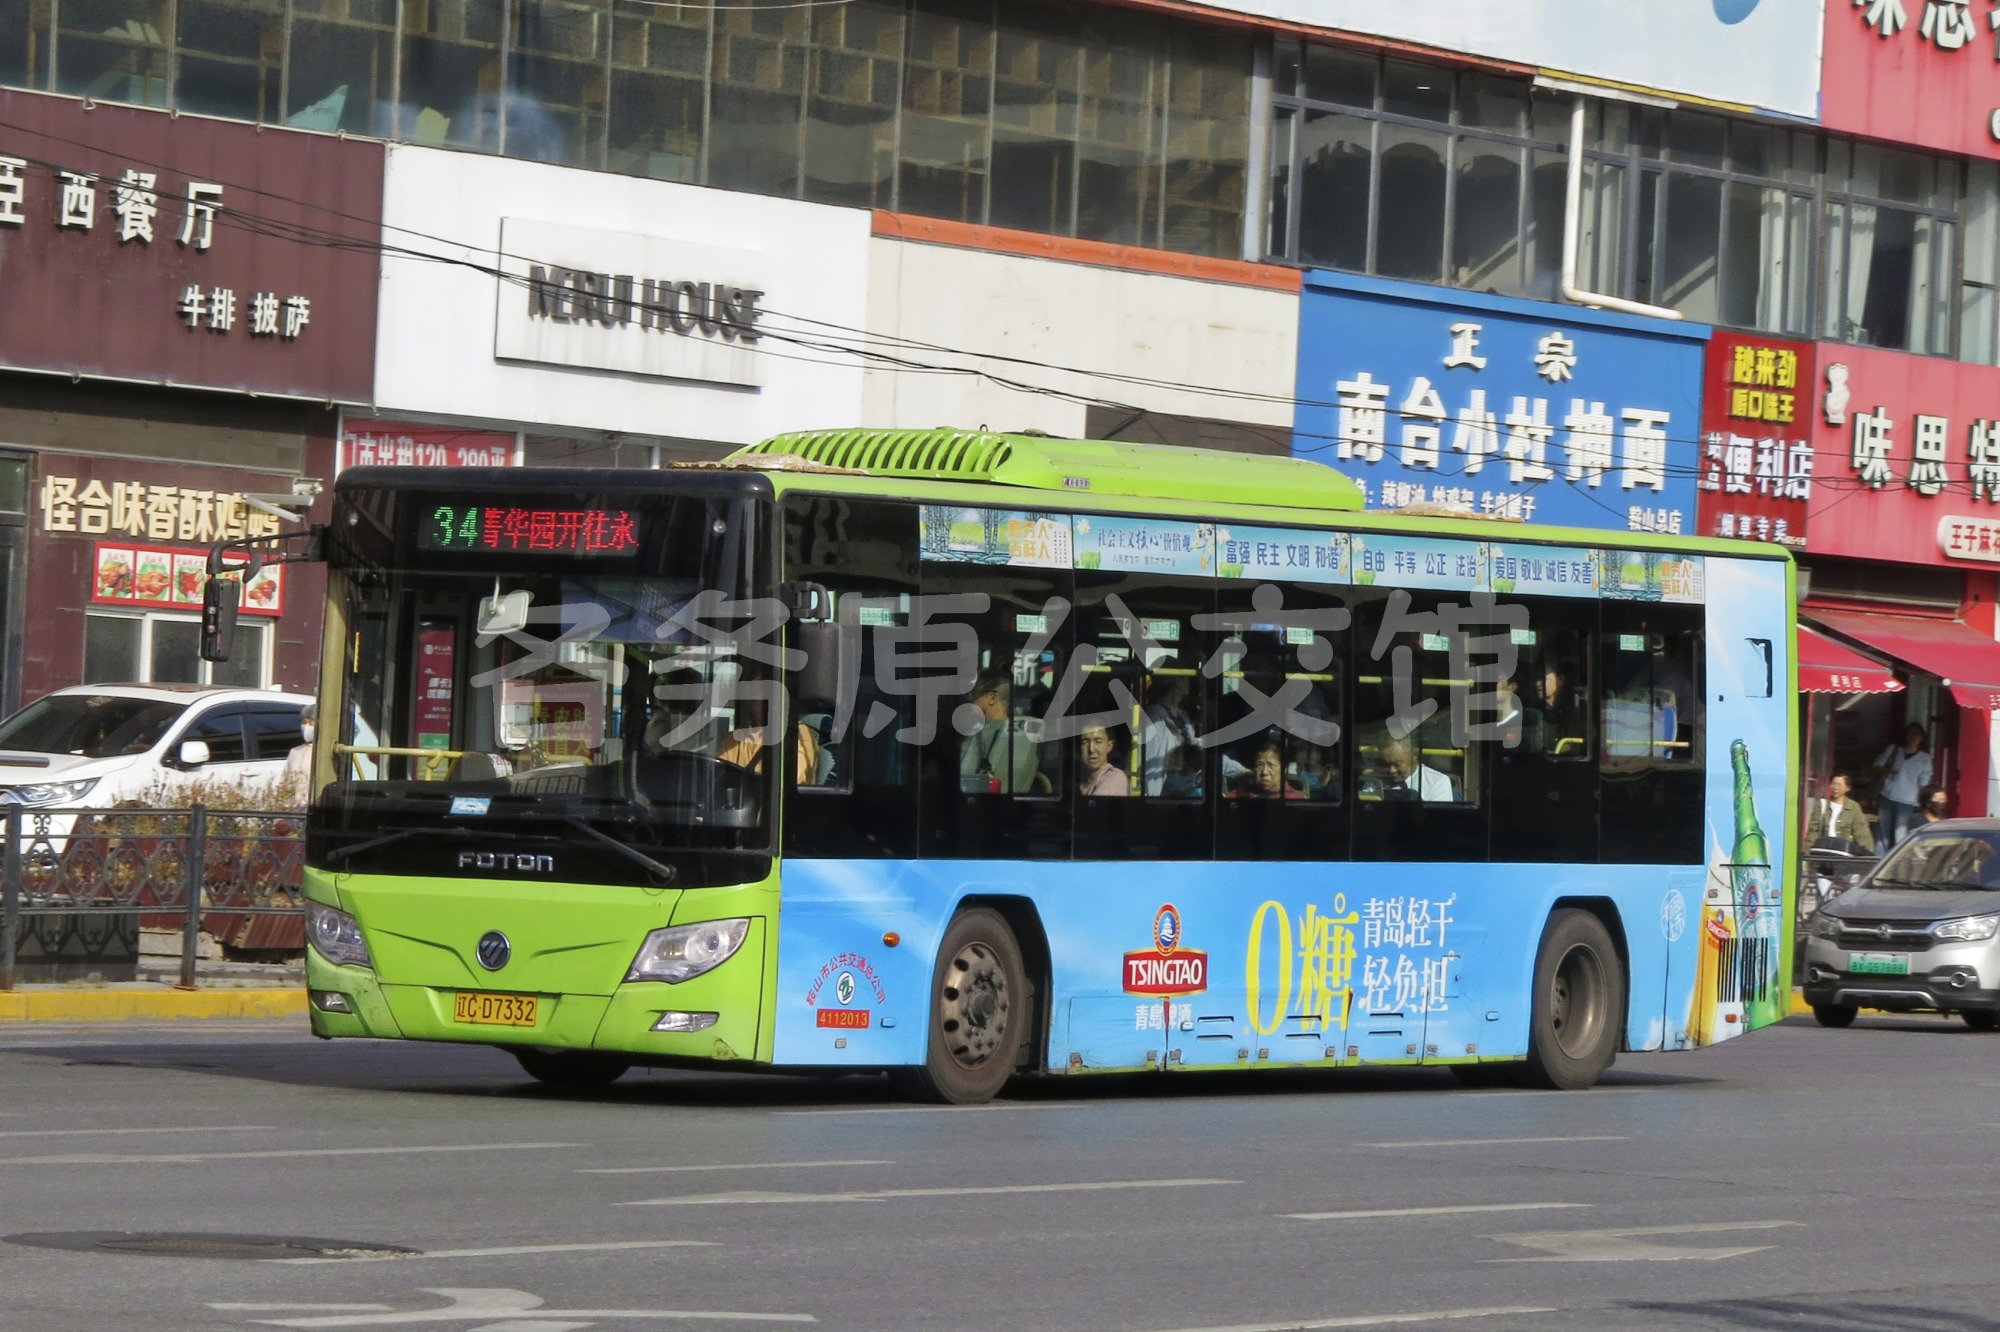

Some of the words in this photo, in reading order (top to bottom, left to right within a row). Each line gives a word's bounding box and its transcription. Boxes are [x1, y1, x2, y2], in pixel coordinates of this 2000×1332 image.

[181, 285, 236, 332] 牛排
[251, 292, 310, 337] 披萨
[528, 265, 634, 330] MERU
[640, 279, 765, 345] HOUSE
[1442, 322, 1577, 382] 正宗
[1725, 433, 1815, 501] 便利店
[433, 505, 479, 547] 34
[1225, 540, 1251, 565] 富强
[1256, 542, 1281, 567] 民主
[1286, 543, 1310, 568] 文明
[1315, 545, 1339, 571] 和谐
[1363, 549, 1386, 573] 自由
[1394, 550, 1417, 575] 平等
[1425, 552, 1448, 577] 公正
[1455, 554, 1477, 578] 法治
[1494, 557, 1517, 580] 爱国
[1521, 558, 1543, 582] 敬业
[1545, 559, 1568, 584] 诚信
[1570, 561, 1593, 585] 友善
[458, 852, 554, 872] FOTON
[1128, 958, 1203, 987] TSINGTAO
[1358, 952, 1455, 1014] 轻负担
[819, 1012, 868, 1027] 4112013
